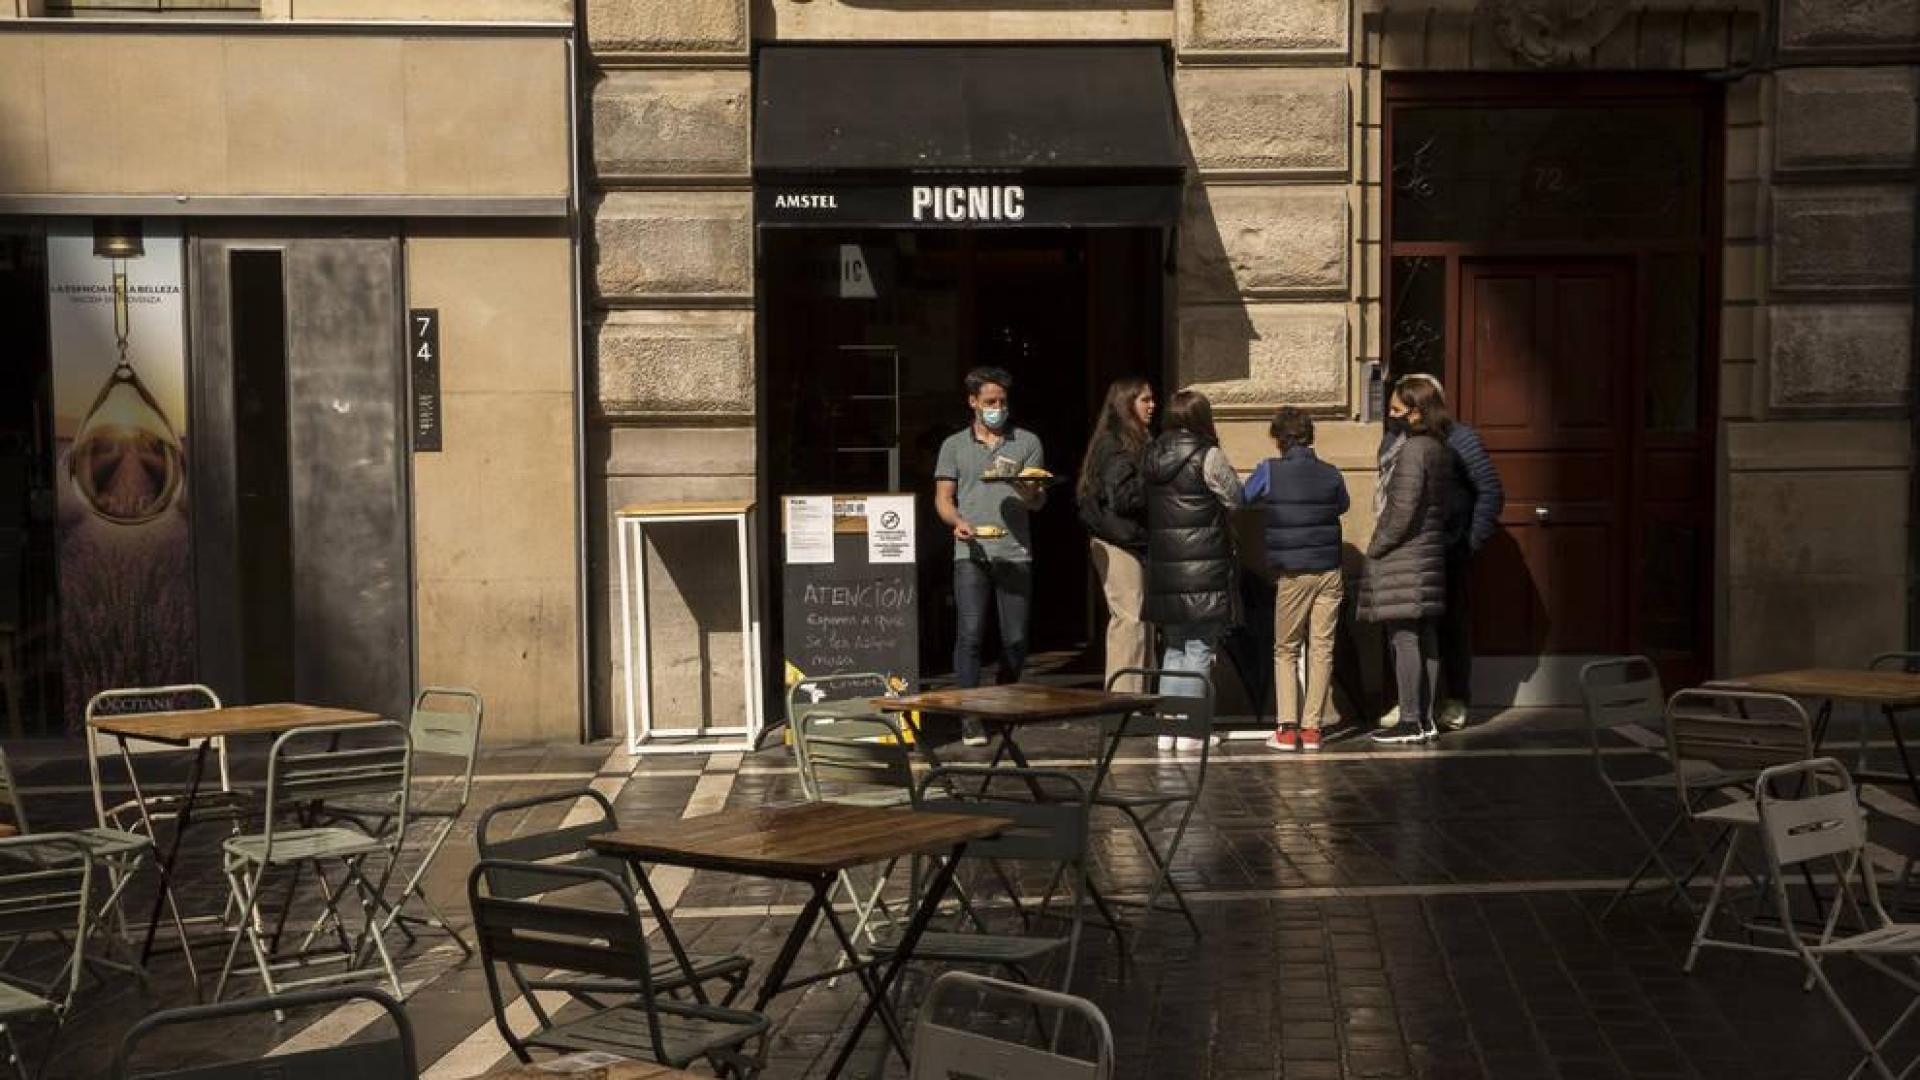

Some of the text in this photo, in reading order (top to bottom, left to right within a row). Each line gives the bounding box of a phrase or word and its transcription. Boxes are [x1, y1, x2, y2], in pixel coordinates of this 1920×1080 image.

[1535, 167, 1565, 190] 72
[775, 195, 838, 208] AMSTEL
[912, 186, 1024, 221] PICNIC
[804, 579, 913, 607] ATENCIÓN
